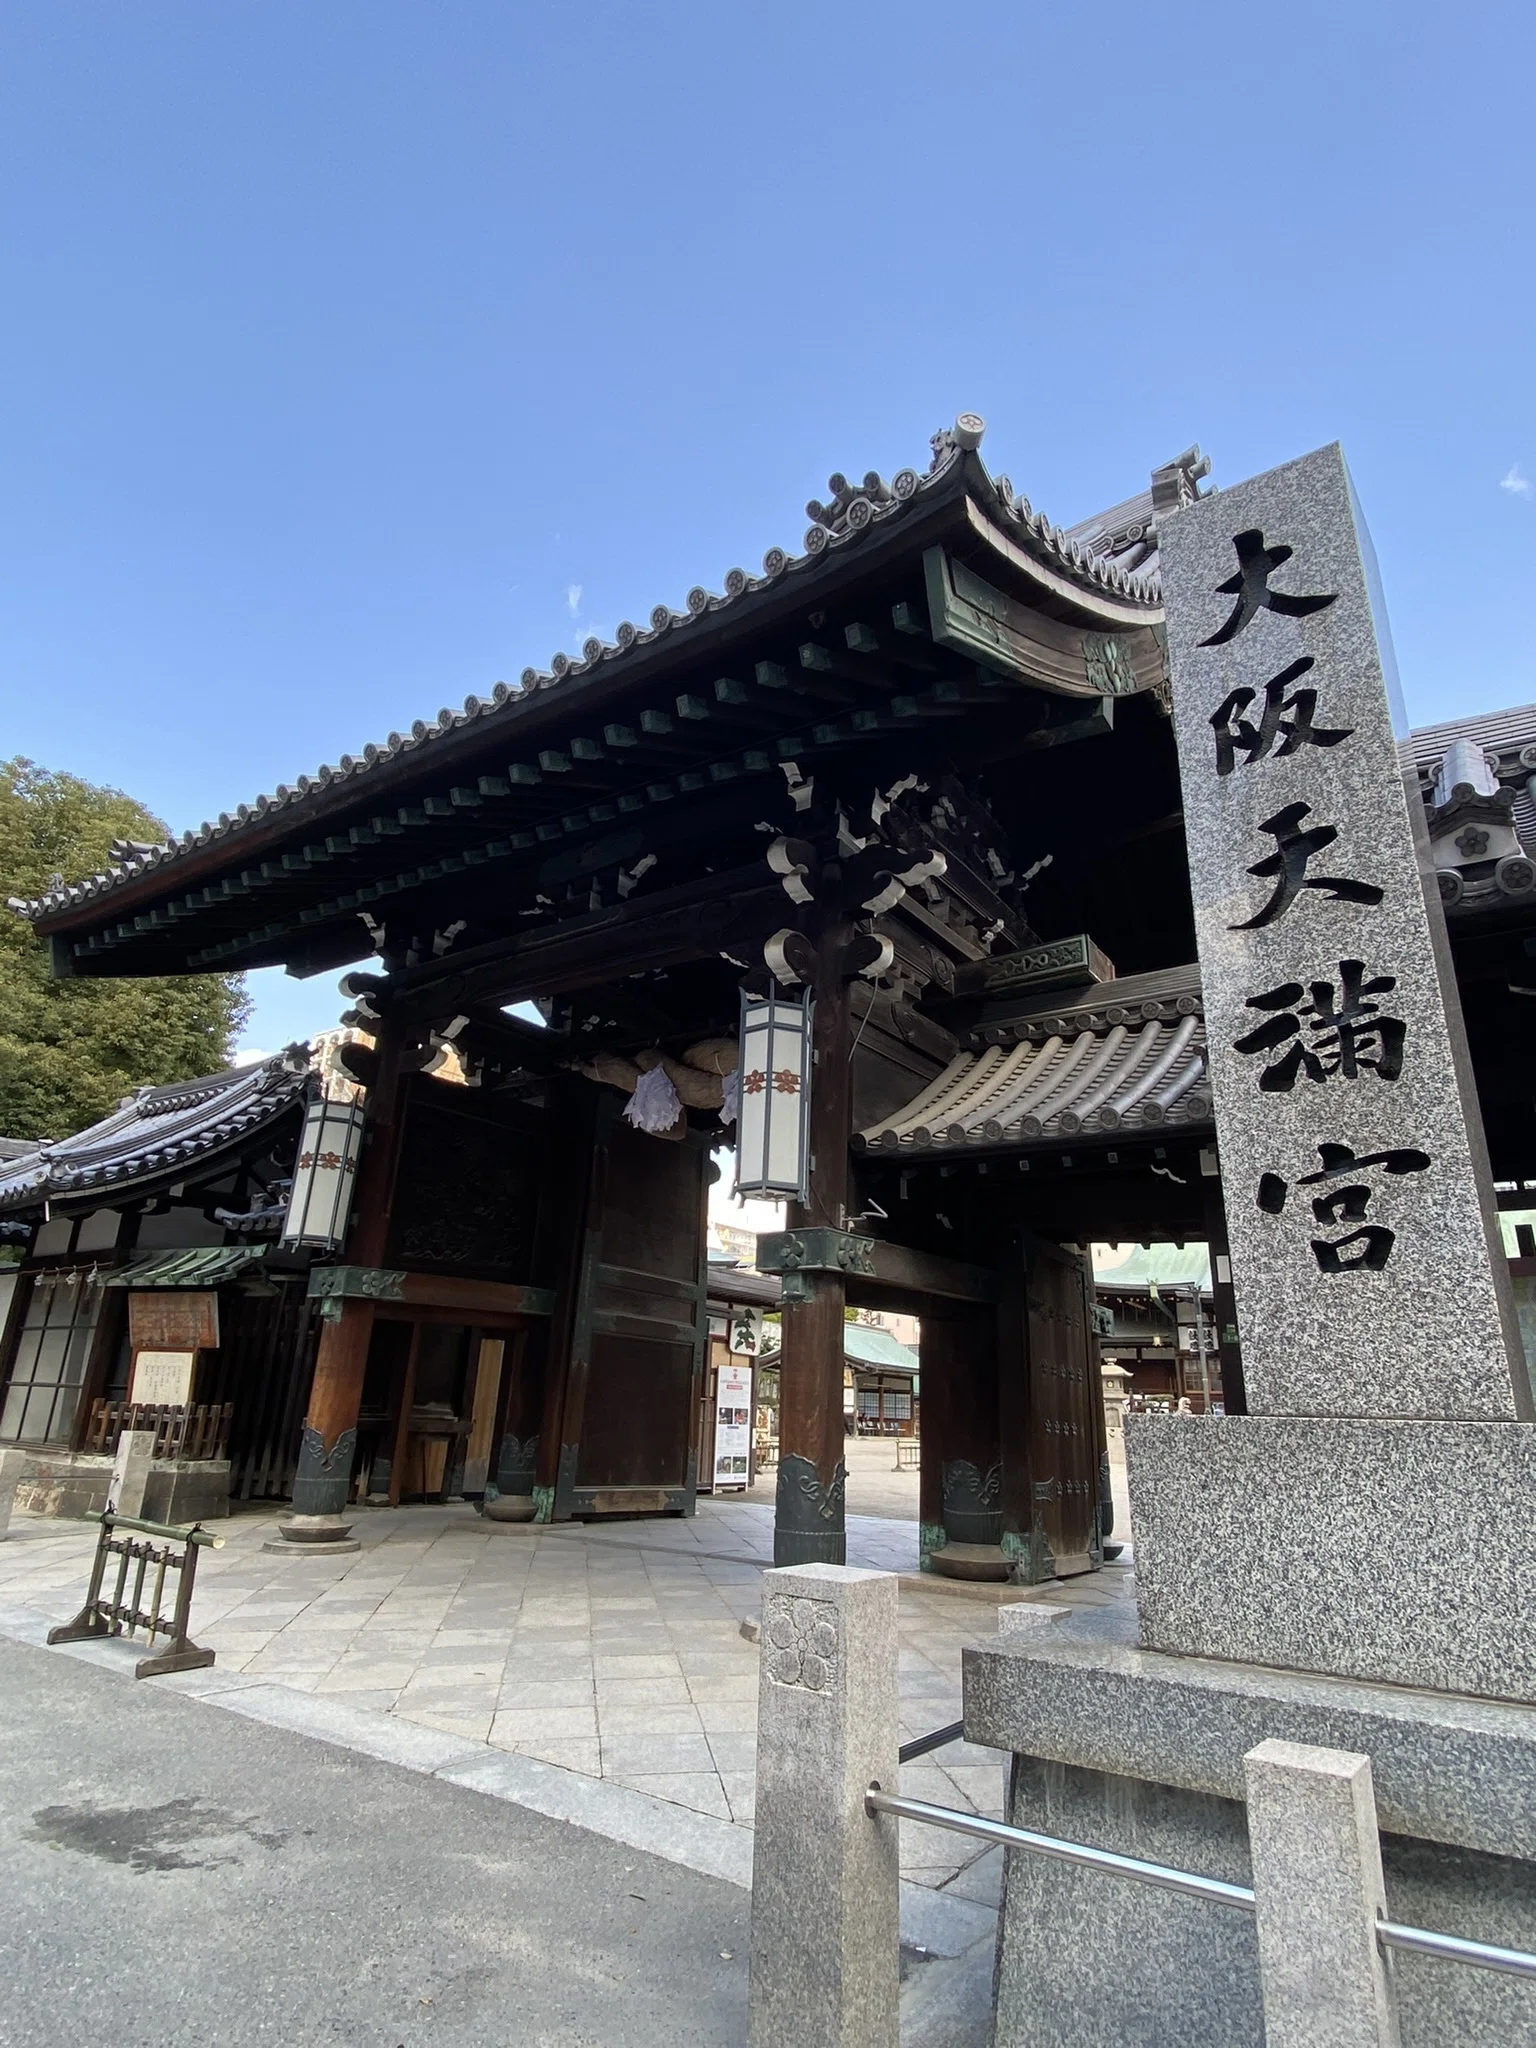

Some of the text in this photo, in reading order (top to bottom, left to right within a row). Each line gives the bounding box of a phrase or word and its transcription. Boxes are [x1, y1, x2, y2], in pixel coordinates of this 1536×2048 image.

[1199, 529, 1431, 1272] 大阪天満宮
